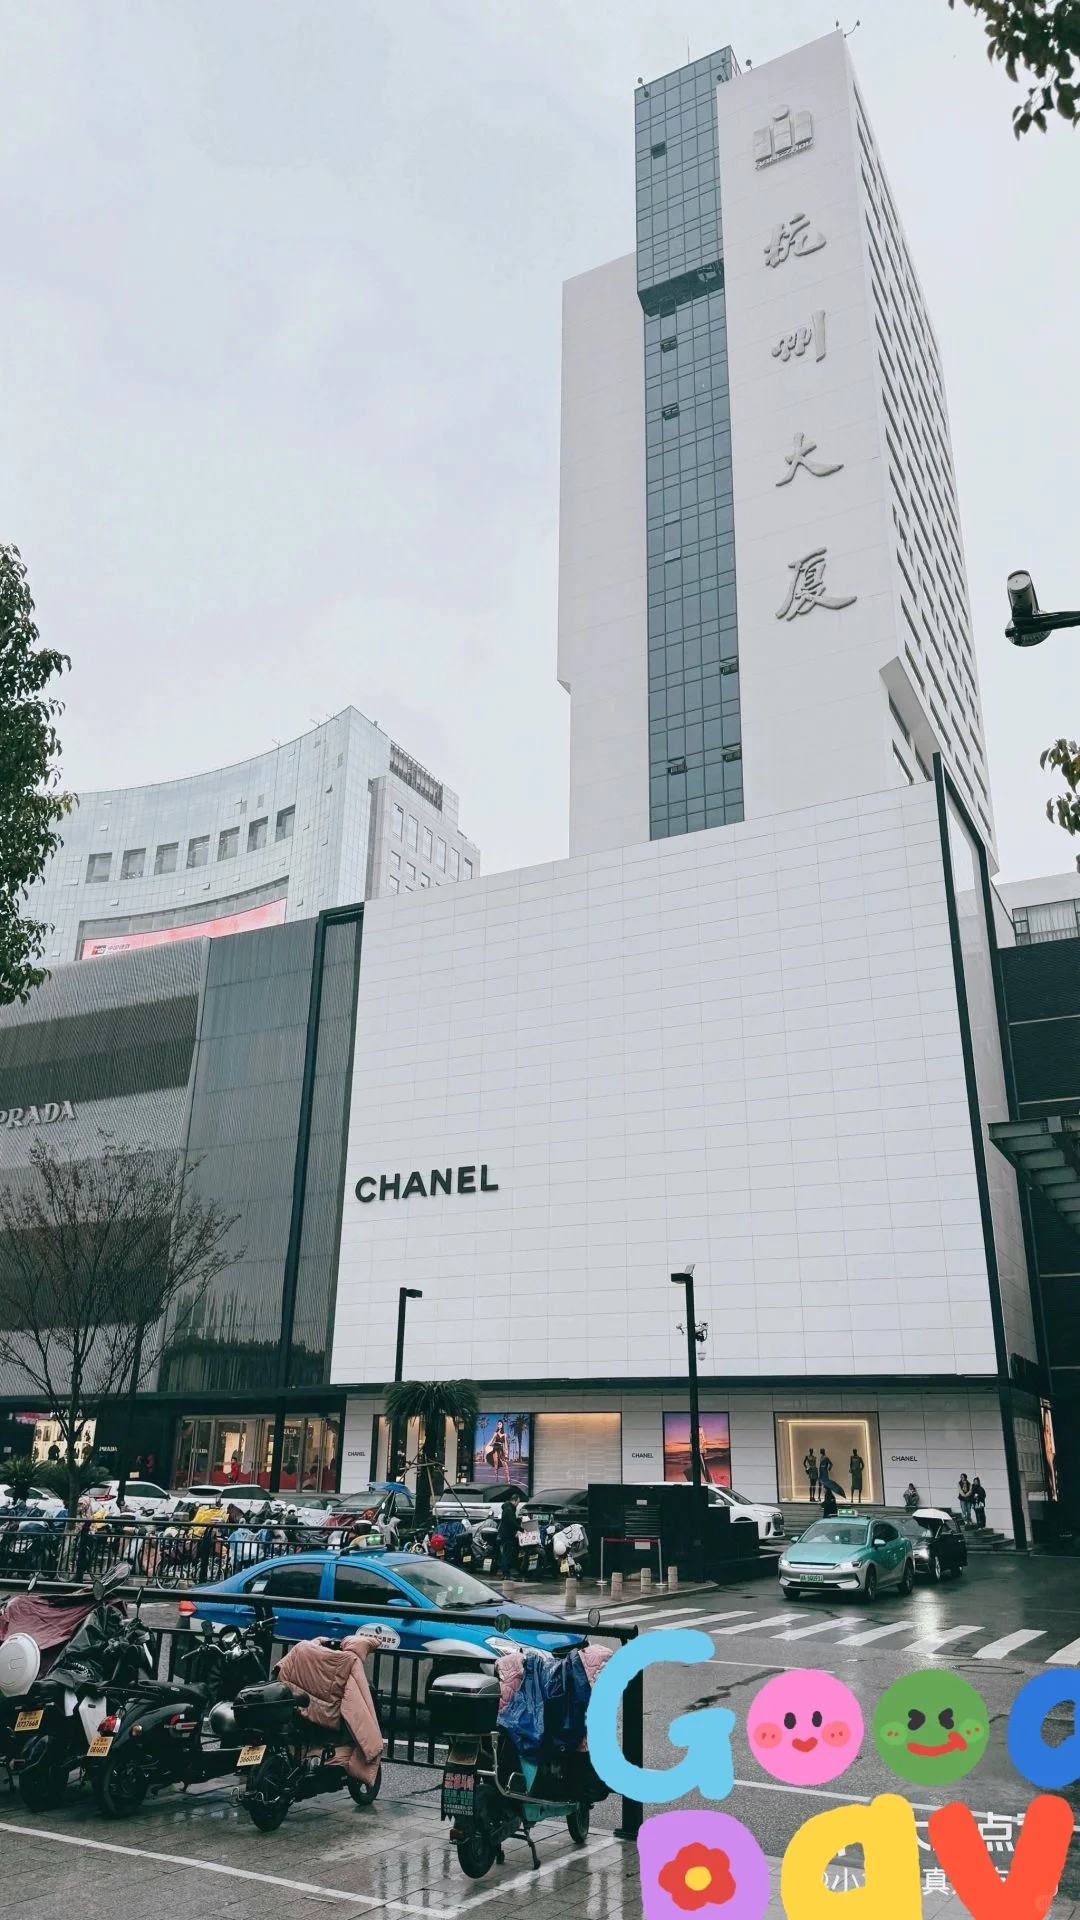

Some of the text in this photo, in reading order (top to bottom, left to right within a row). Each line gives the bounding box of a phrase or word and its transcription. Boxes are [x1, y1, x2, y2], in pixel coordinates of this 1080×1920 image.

[764, 212, 858, 622] 杭州大厦
[355, 1164, 499, 1203] CHANEL
